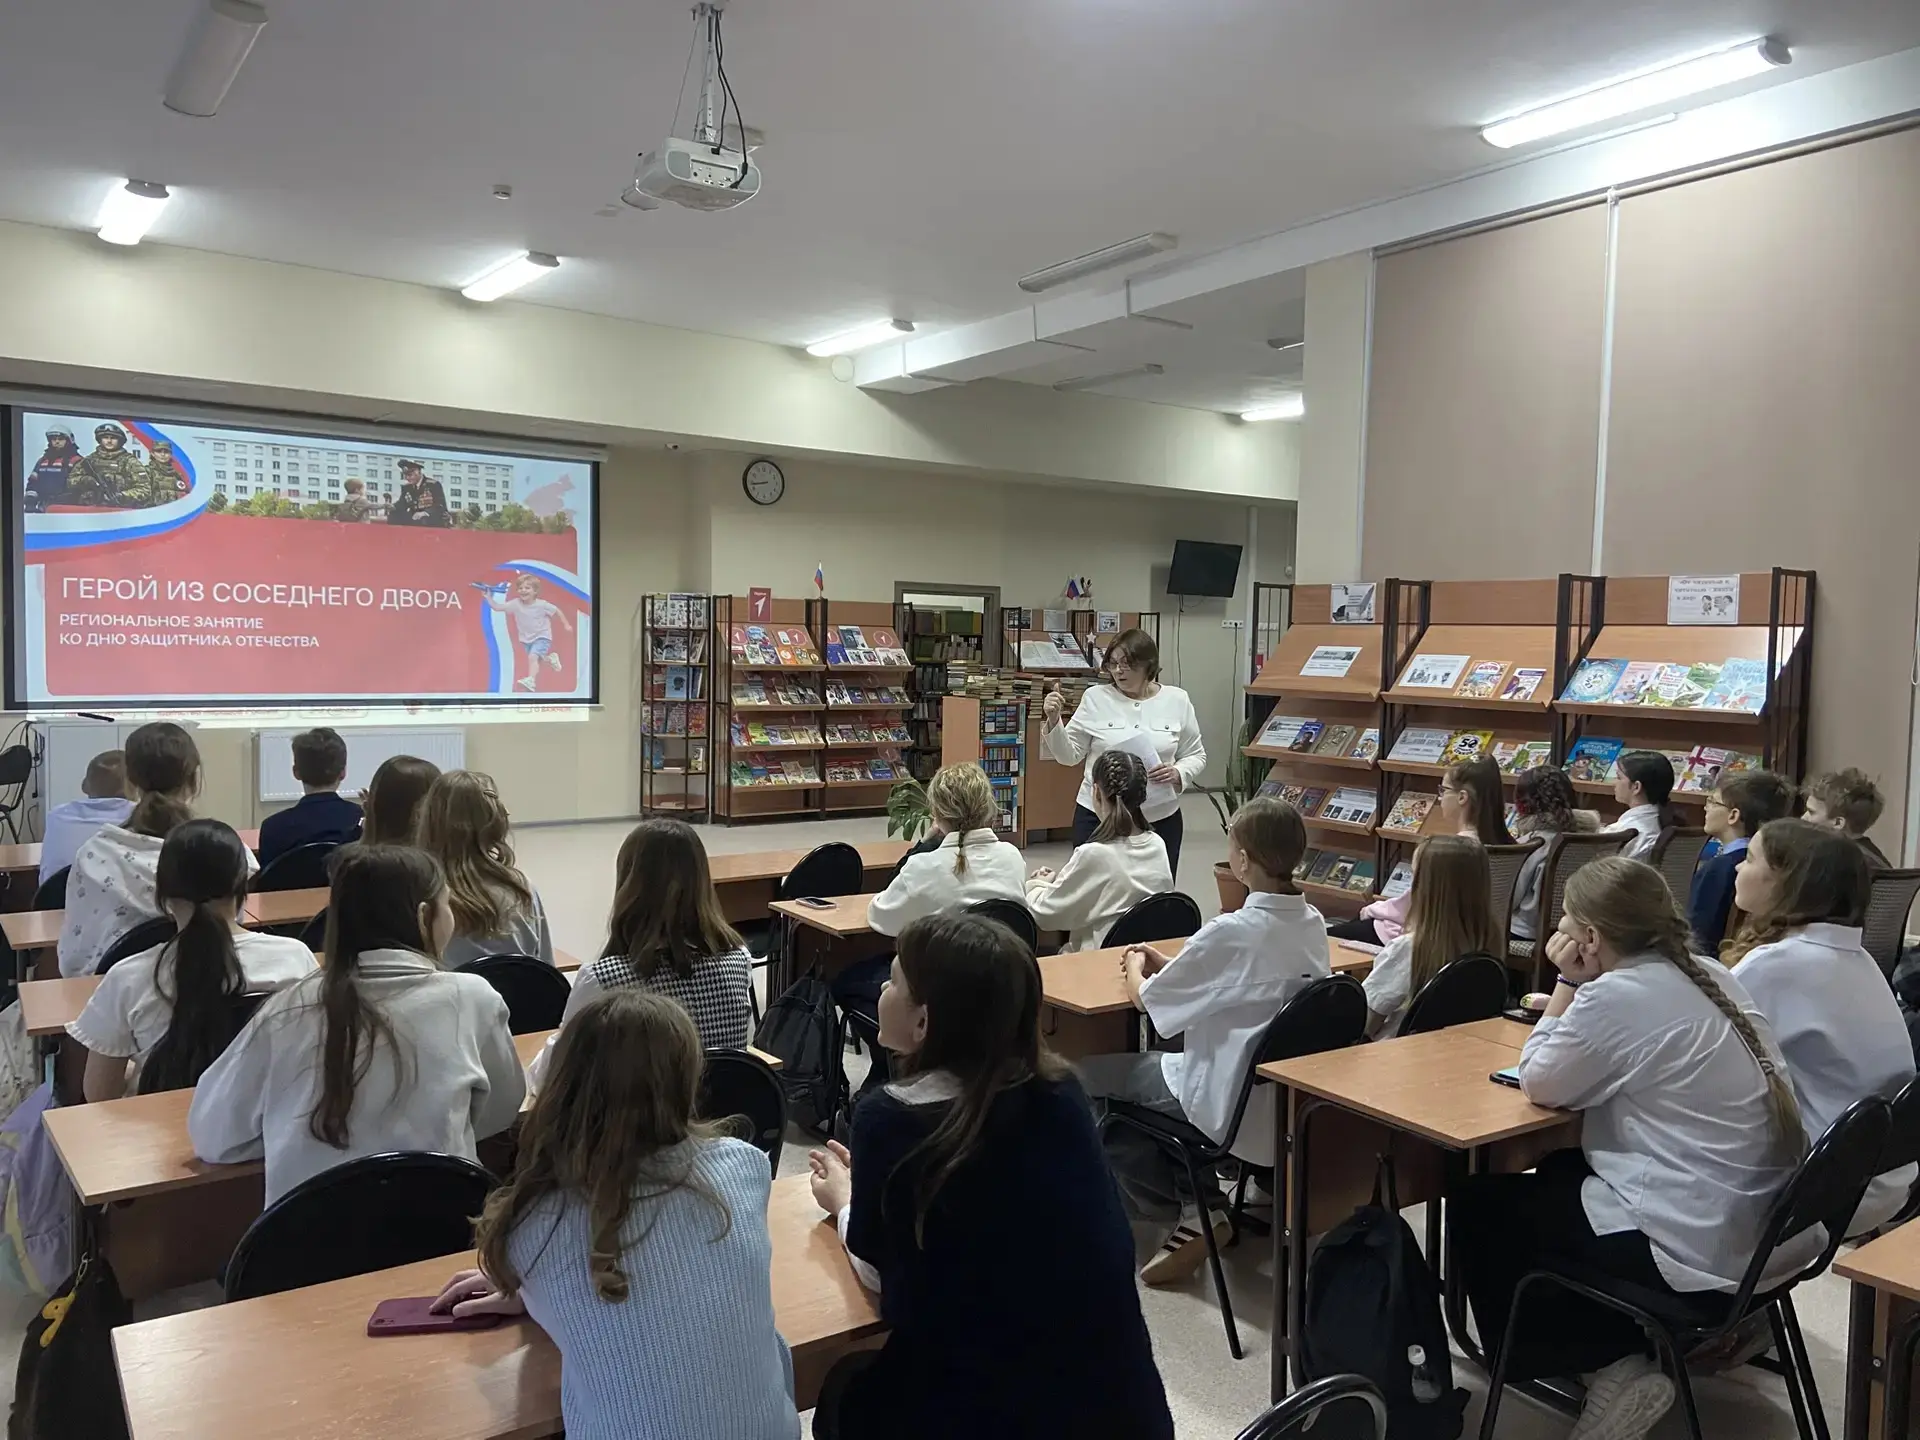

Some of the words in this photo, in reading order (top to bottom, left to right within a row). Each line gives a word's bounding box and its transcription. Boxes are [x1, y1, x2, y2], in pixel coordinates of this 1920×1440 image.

[62, 574, 158, 601] ГЕРОЙ
[167, 580, 204, 602] ИЗ
[212, 582, 374, 608] СОСЕДНЕГО
[380, 588, 462, 611] ДВОРА
[59, 613, 190, 628] РЕГИОНАЛЬНОЕ
[193, 616, 264, 629] ЗАНЯТИЕ
[59, 633, 82, 645] КО
[86, 633, 127, 647] ДНЮ
[130, 634, 232, 647] ЗАЩИТНИКА
[235, 635, 320, 648] ОТЕЧЕСТВА
